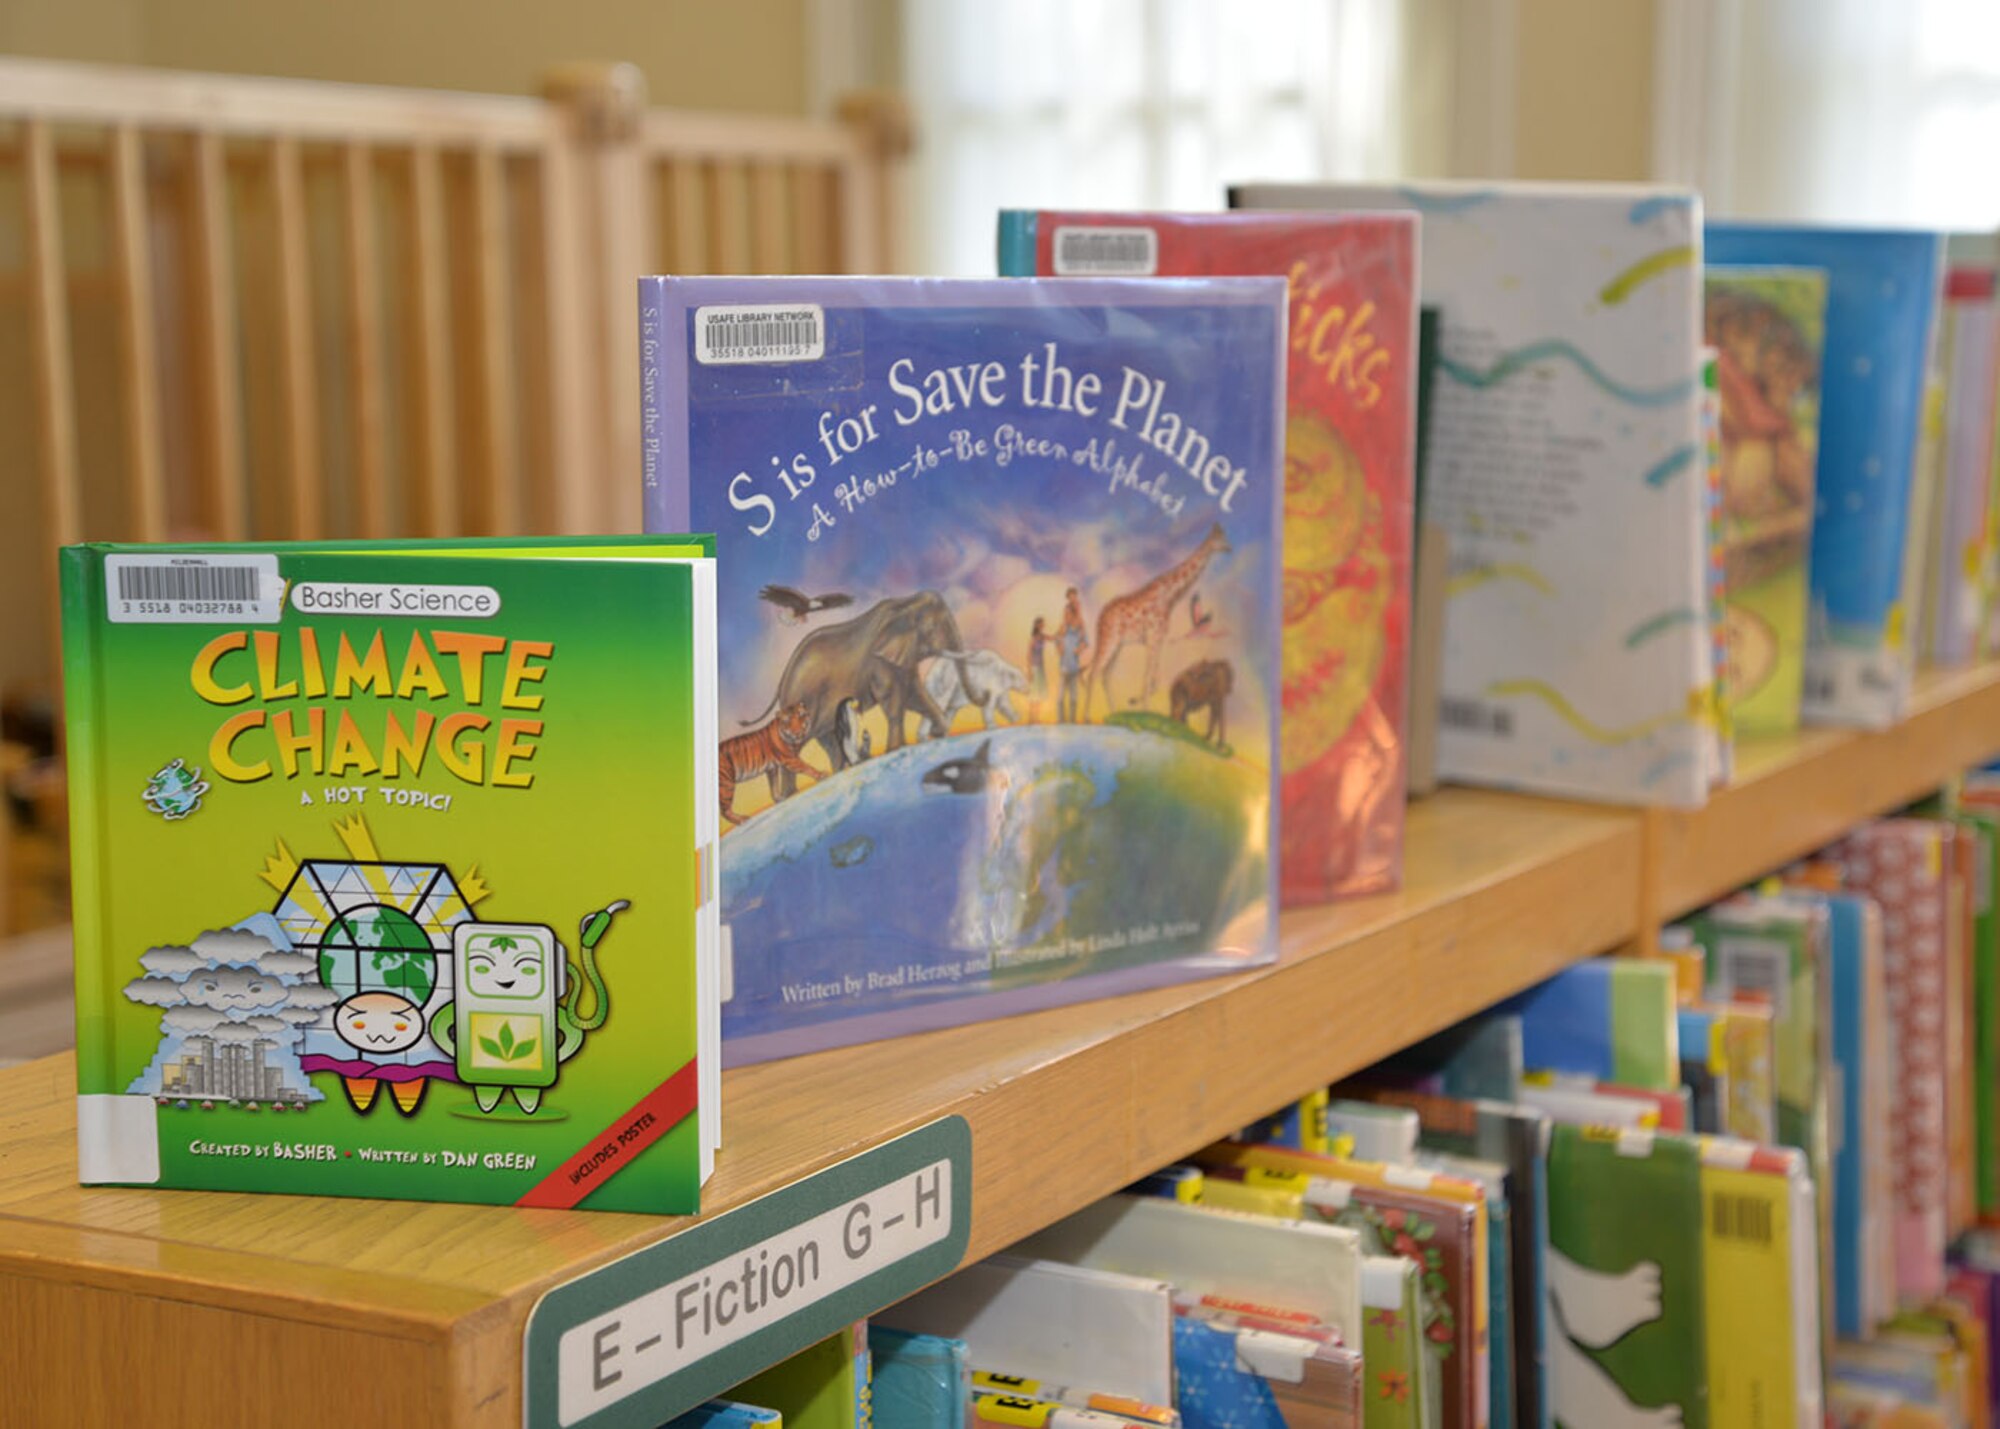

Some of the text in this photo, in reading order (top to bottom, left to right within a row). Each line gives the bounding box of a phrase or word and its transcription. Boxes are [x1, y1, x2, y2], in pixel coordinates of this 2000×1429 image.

[707, 311, 814, 324] USAFE LIBRARY NETWORK
[710, 347, 744, 359] 35518
[643, 307, 660, 488] S is for Save the Planet
[728, 342, 1248, 537] S is for Save the Planet
[807, 503, 836, 541] A
[994, 423, 1068, 467] Green
[1071, 437, 1188, 516] Alphabet
[122, 602, 259, 614] 3 5518 04032788 4
[302, 585, 491, 612] Basher Science
[190, 626, 555, 711] CLIMATE
[208, 707, 545, 789] CHANGE
[301, 786, 452, 812] A HOT TOPIC!
[781, 981, 841, 1004] Written
[843, 974, 864, 998] by
[867, 965, 904, 990] Brad
[907, 962, 962, 983] Herzog
[964, 951, 991, 974] and
[189, 1139, 337, 1161] CREATED BY BASHER
[358, 1147, 537, 1170] WRITTEN BY DAN GREEN
[569, 1112, 656, 1185] INCLUDES POSTER
[593, 1320, 622, 1391] E
[675, 1239, 819, 1350] Fiction
[843, 1201, 872, 1260] G
[915, 1166, 941, 1229] H
